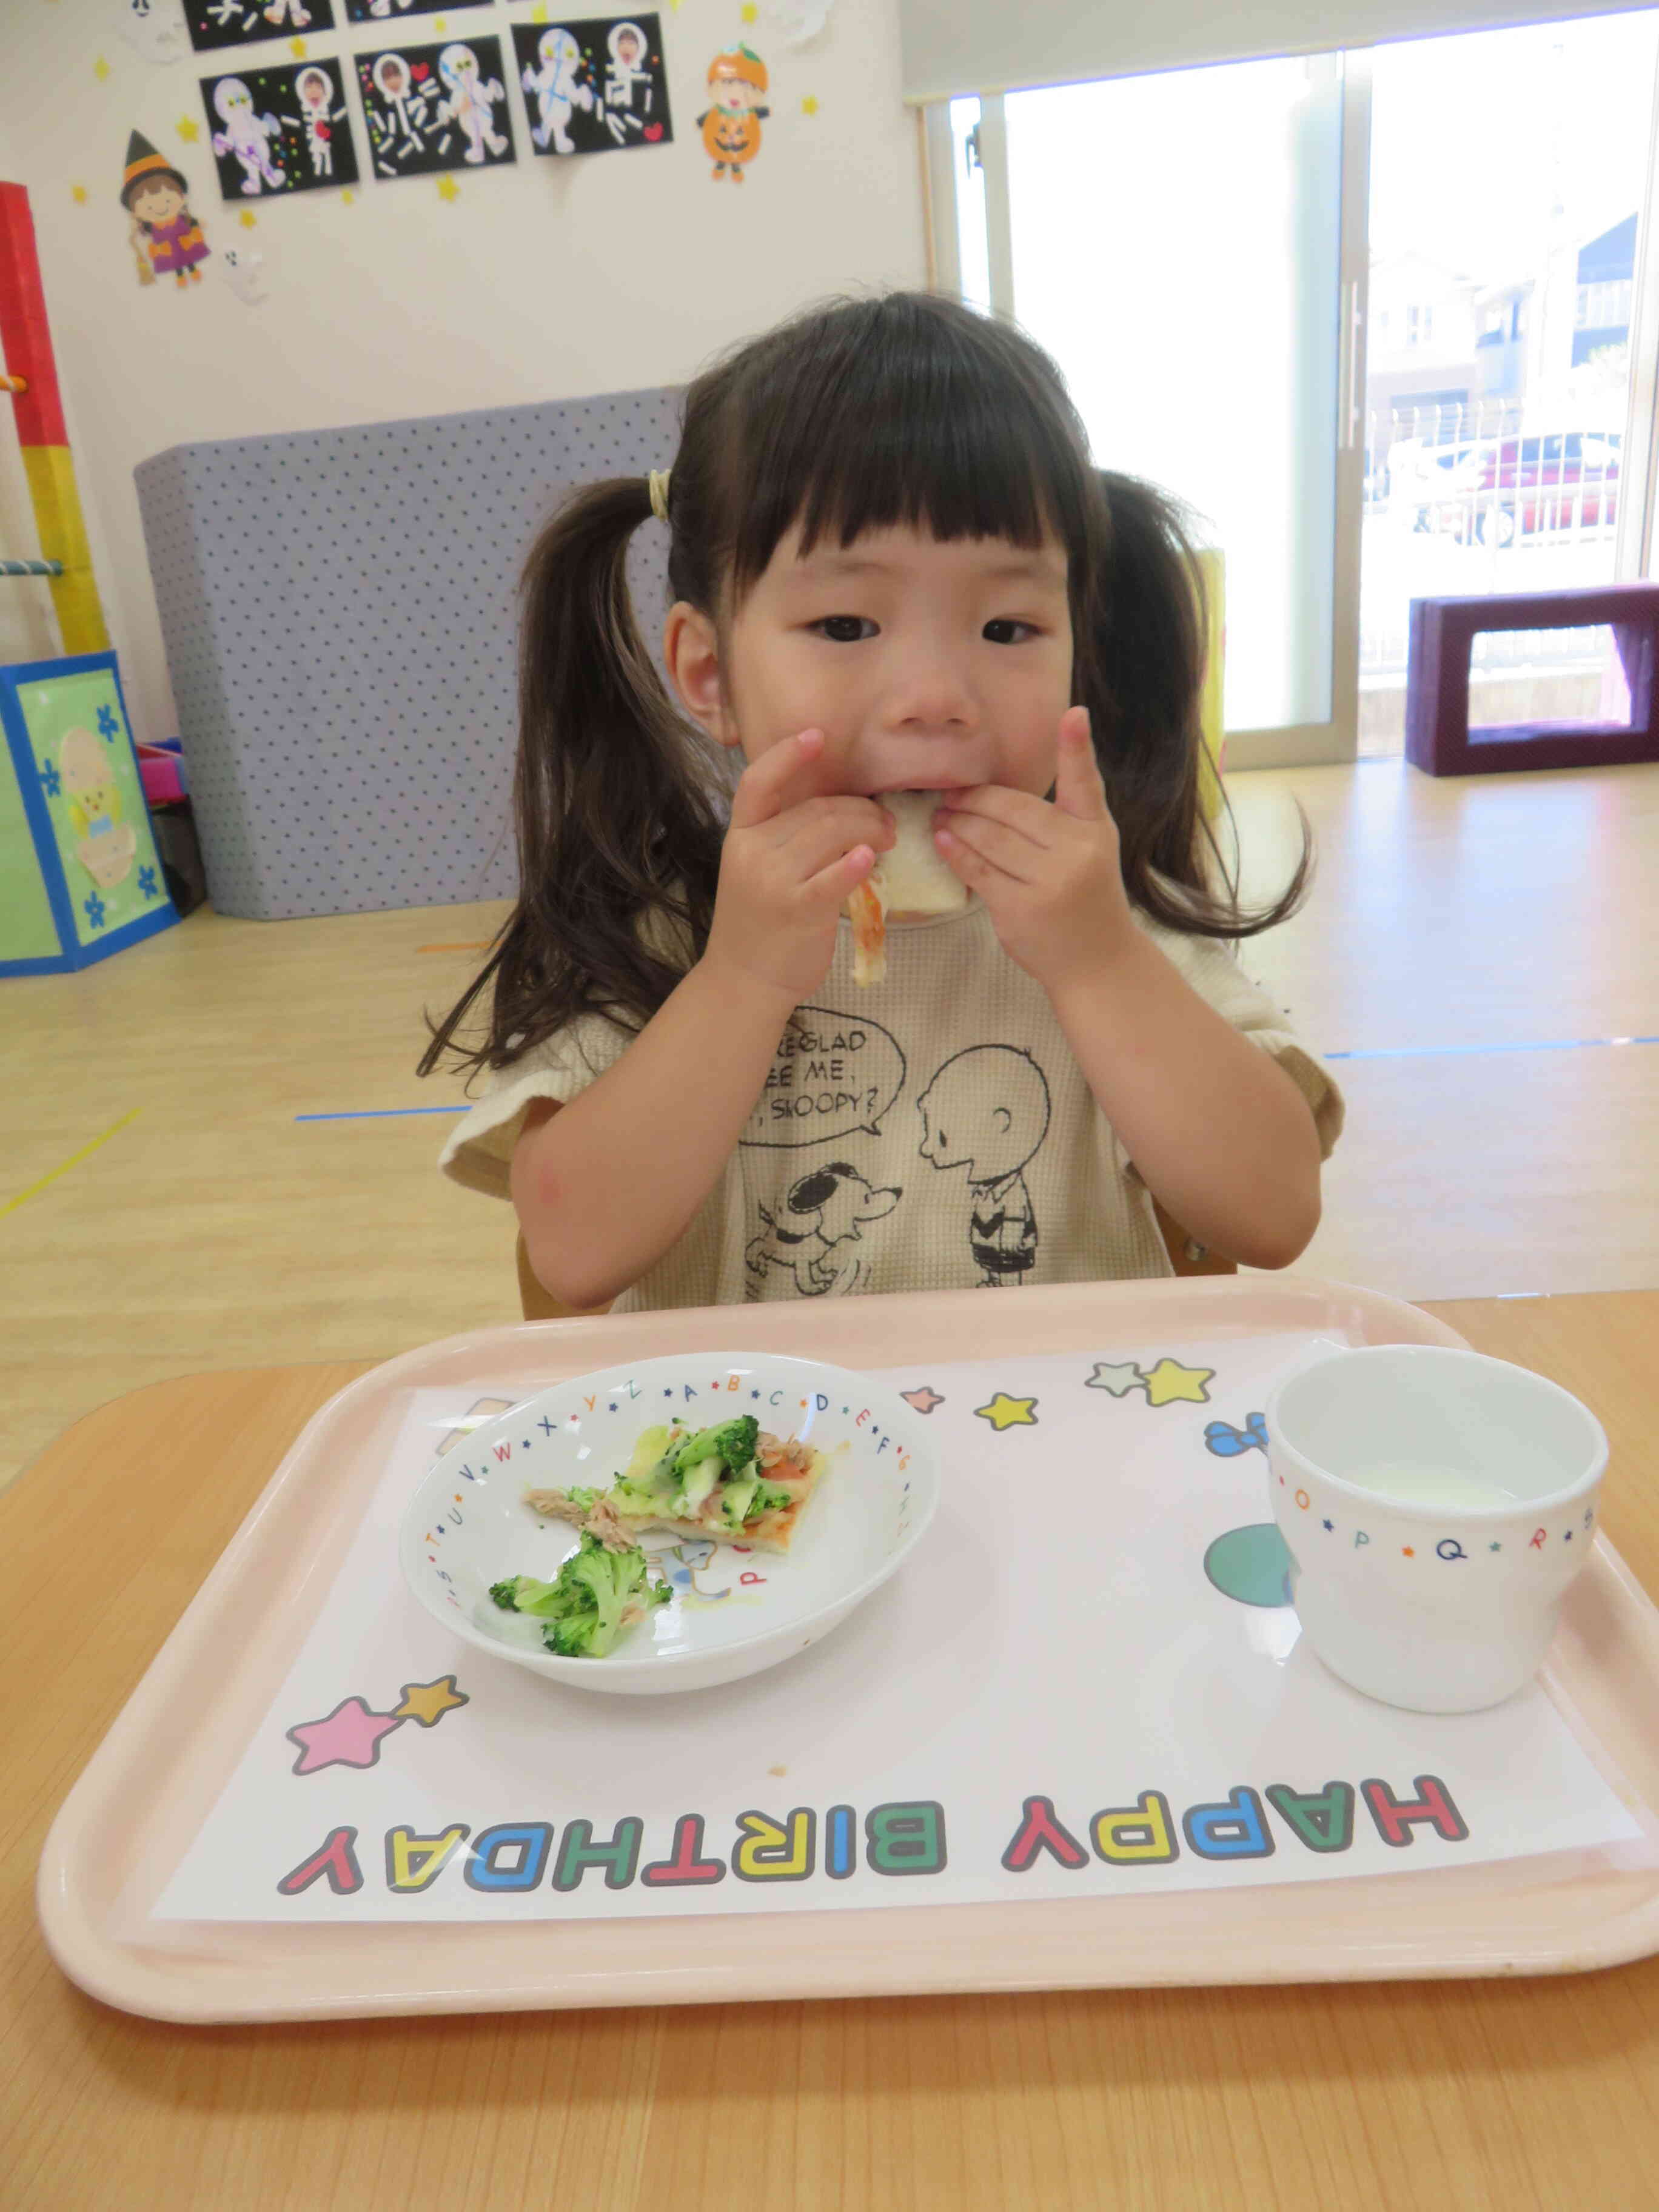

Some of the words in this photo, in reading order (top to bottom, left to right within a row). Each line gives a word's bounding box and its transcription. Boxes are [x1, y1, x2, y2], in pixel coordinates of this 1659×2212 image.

[799, 1030, 866, 1052] GLAD
[459, 1464, 475, 1481] V
[492, 1442, 511, 1462] W
[537, 1416, 557, 1436] X
[584, 1395, 596, 1412] Y
[685, 1384, 697, 1402] A
[728, 1375, 740, 1392] B
[769, 1390, 784, 1406] C
[816, 1394, 829, 1411] D
[856, 1409, 871, 1427] E
[877, 1436, 890, 1454] F
[1355, 1530, 1369, 1549] P
[1436, 1539, 1468, 1560] Q
[1529, 1527, 1547, 1550] R
[276, 1800, 947, 1895] BIRTHDAY
[1001, 1774, 1469, 1872] HAPPY
